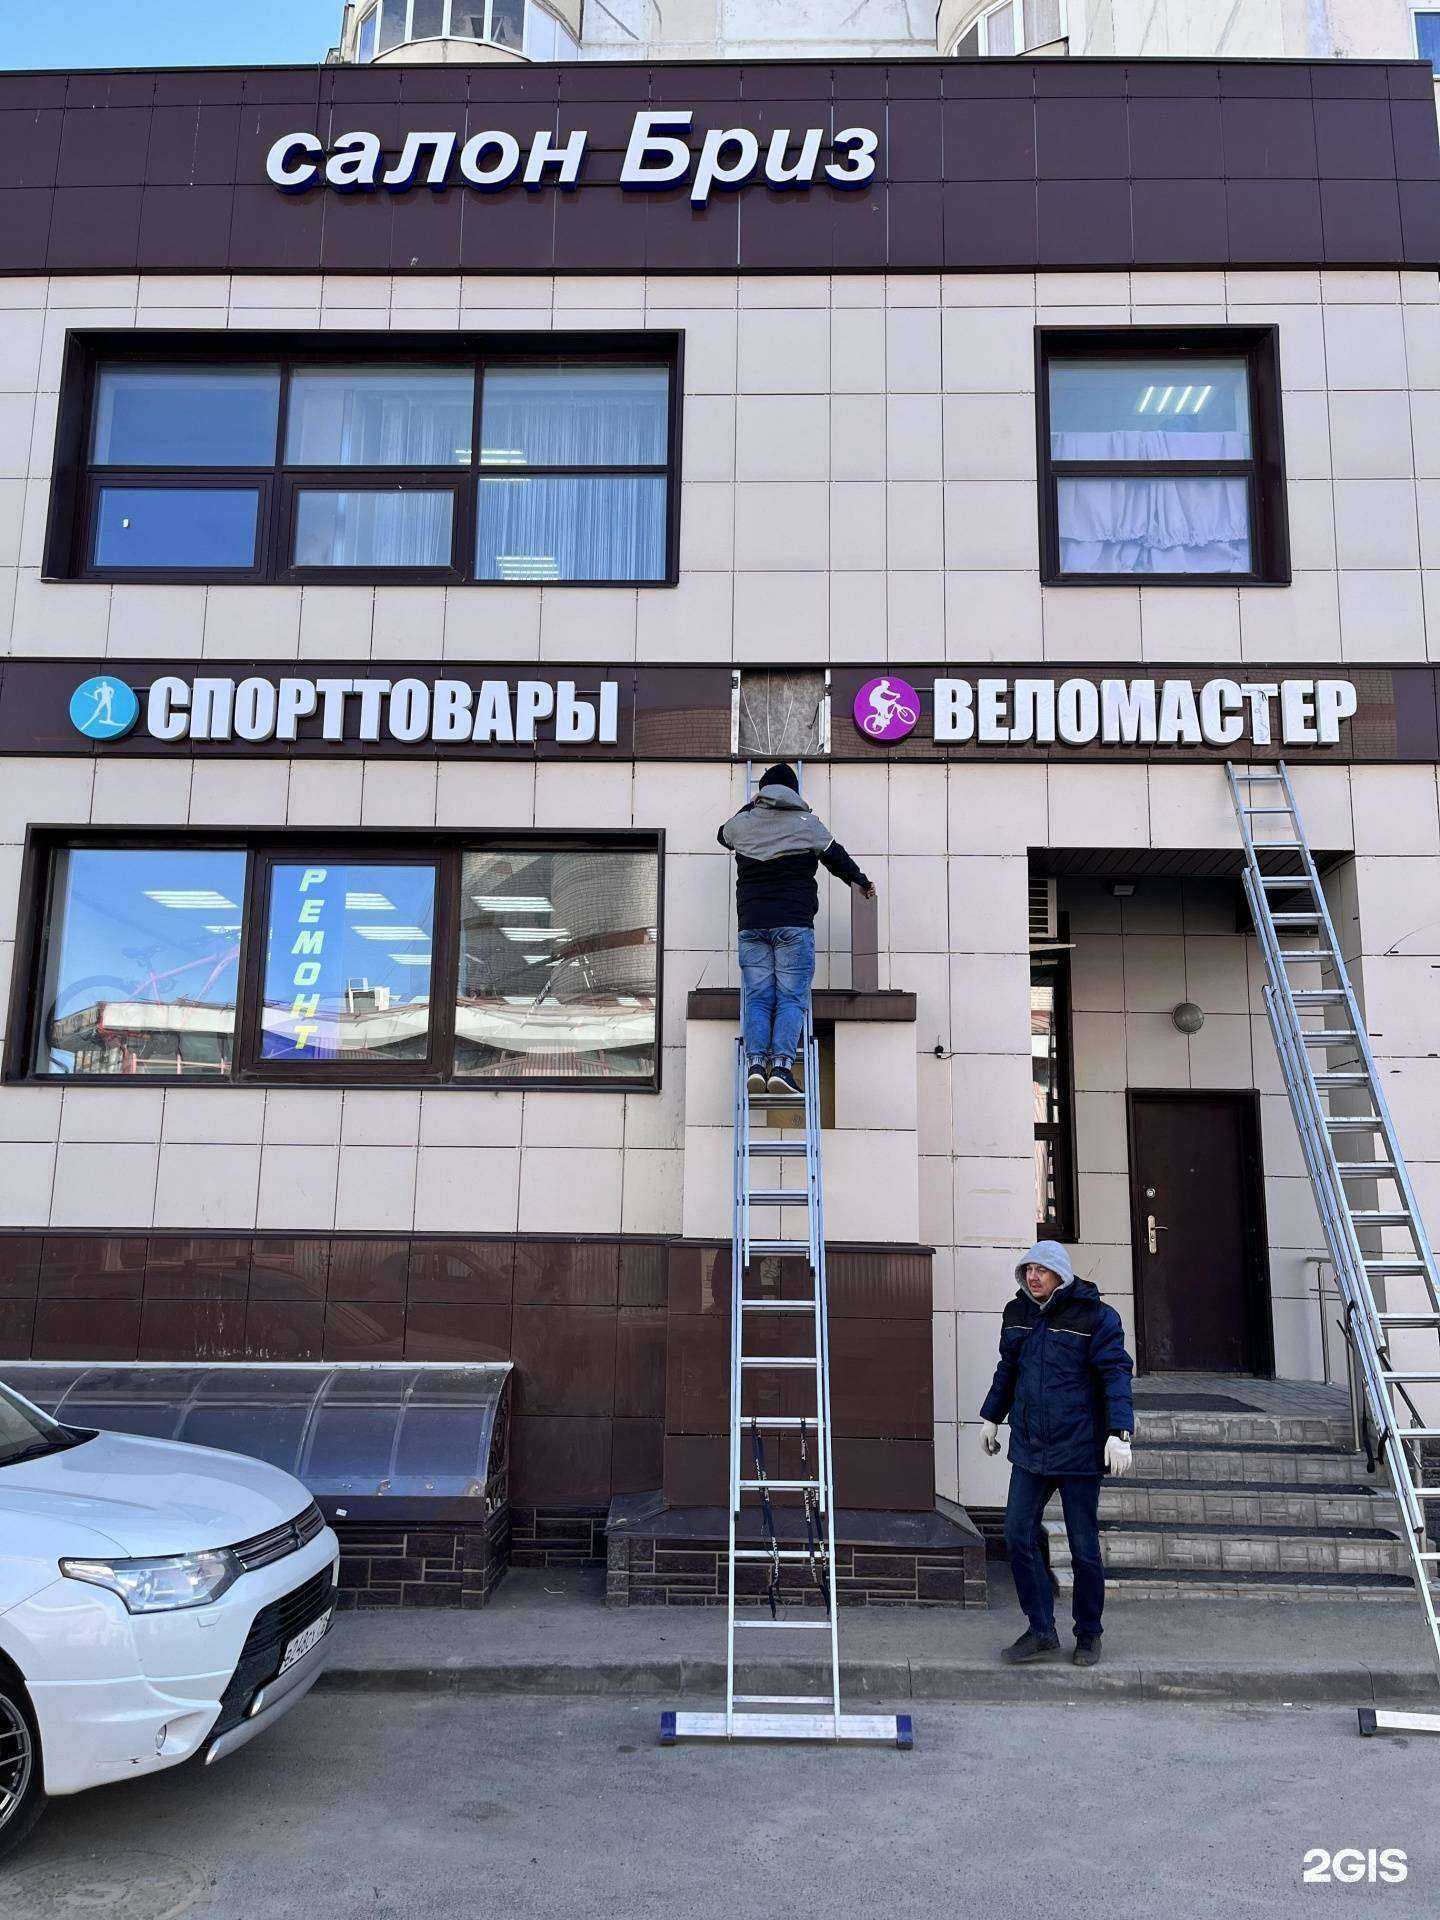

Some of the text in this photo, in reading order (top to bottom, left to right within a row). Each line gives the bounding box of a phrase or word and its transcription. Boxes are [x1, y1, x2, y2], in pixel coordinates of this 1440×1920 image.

[266, 111, 879, 207] салон Бриз
[147, 677, 619, 745] СПОРТТОВАРЫ
[933, 678, 1358, 746] ВЕЛОМАСТЕР
[291, 868, 328, 1050] РЕМОНТ
